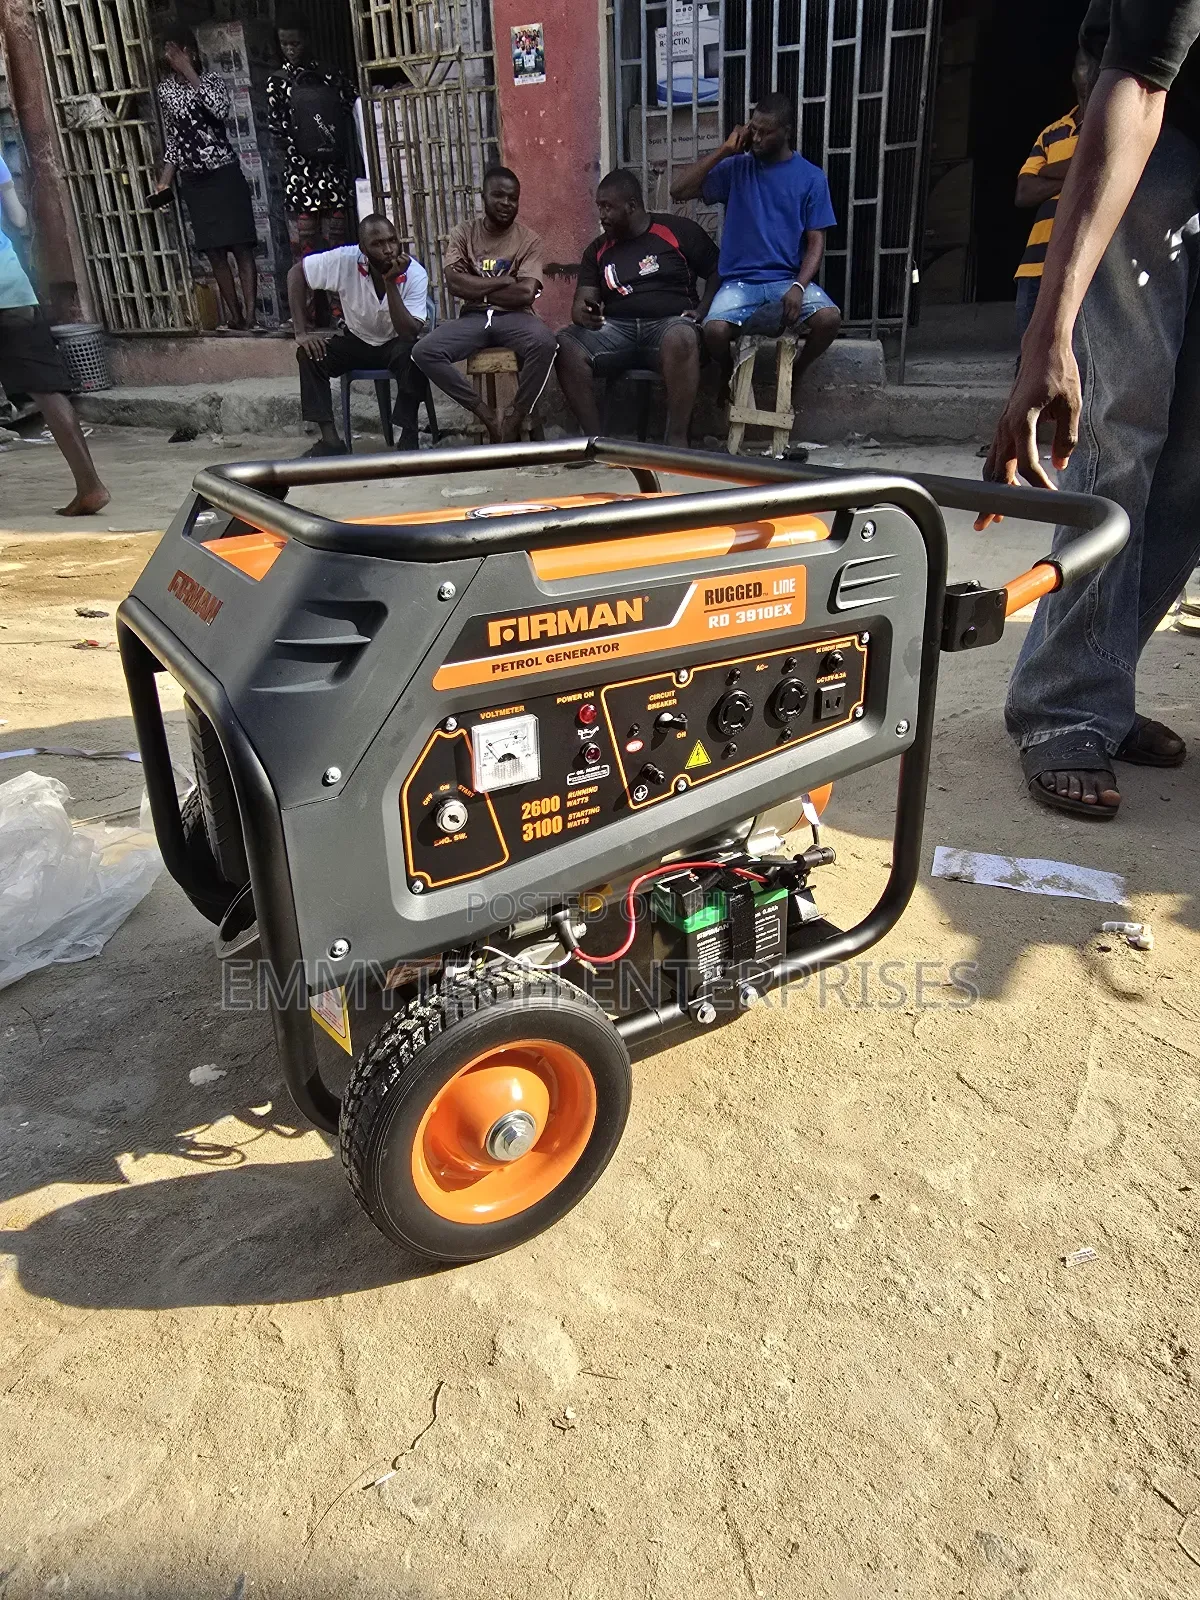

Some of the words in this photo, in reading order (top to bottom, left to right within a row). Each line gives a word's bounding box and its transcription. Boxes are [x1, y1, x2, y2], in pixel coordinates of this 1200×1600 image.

[167, 569, 223, 627] FIRMAN
[704, 581, 763, 606] RUGGED
[773, 578, 796, 596] LINE
[708, 613, 730, 629] RD
[491, 656, 543, 674] PETROL
[545, 642, 620, 664] GENERATOR
[556, 693, 582, 704] POWER
[583, 691, 595, 699] ON
[648, 690, 676, 701] CIRCUIT
[647, 699, 678, 710] BREAKER
[480, 705, 525, 720] VOLTMETER
[457, 784, 475, 798] START
[567, 785, 599, 799] RUNNING
[521, 795, 560, 820] 2600
[566, 796, 589, 808] WATTS
[567, 805, 601, 820] STARTING
[522, 815, 563, 842] 3100
[566, 817, 590, 829] WATTS
